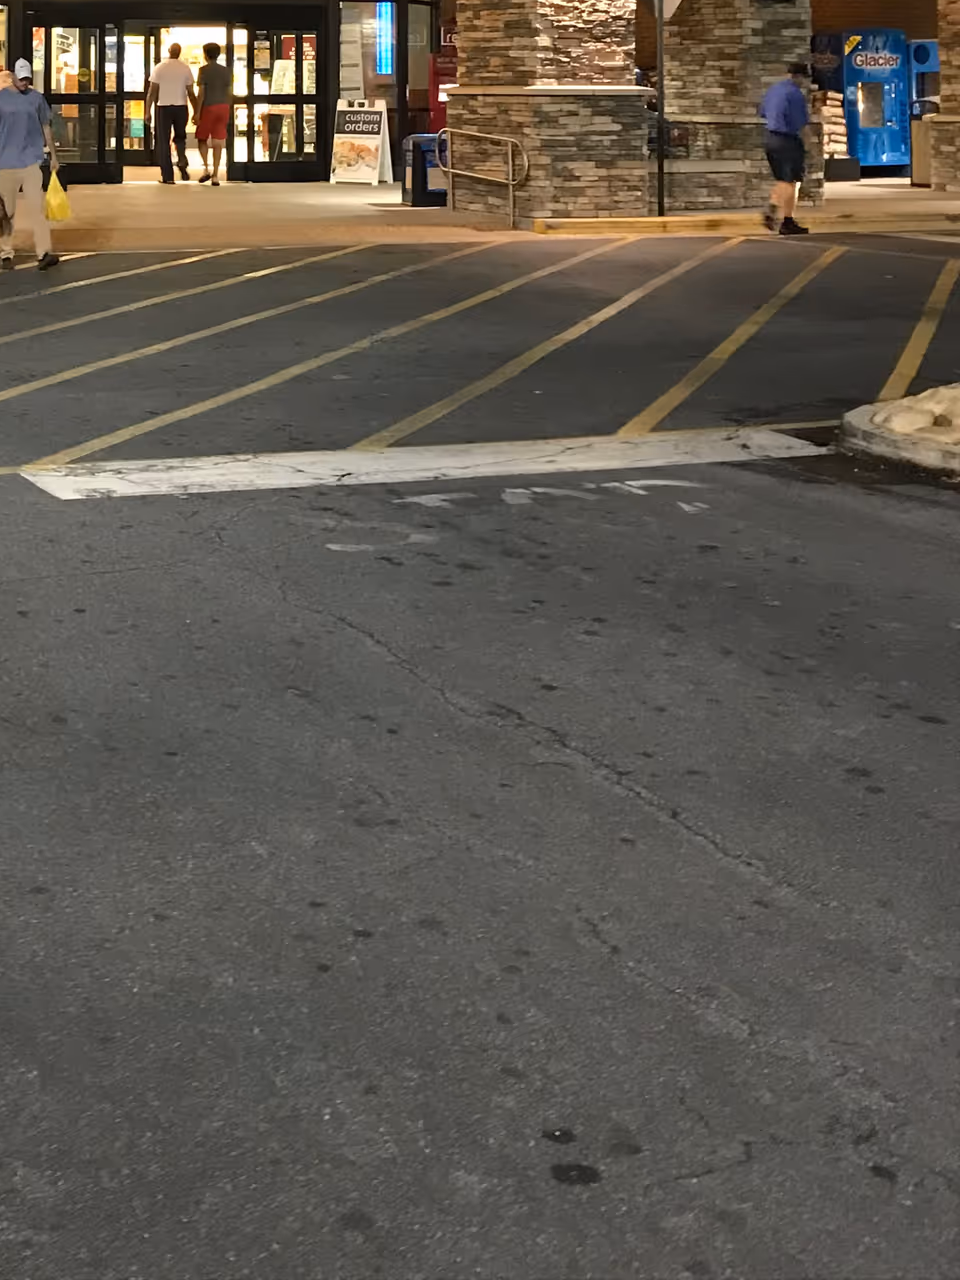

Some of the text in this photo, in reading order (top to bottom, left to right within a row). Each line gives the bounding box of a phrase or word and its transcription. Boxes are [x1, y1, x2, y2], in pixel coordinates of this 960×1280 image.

[854, 53, 900, 67] Glacier
[345, 113, 380, 122] custom
[344, 121, 379, 132] orders
